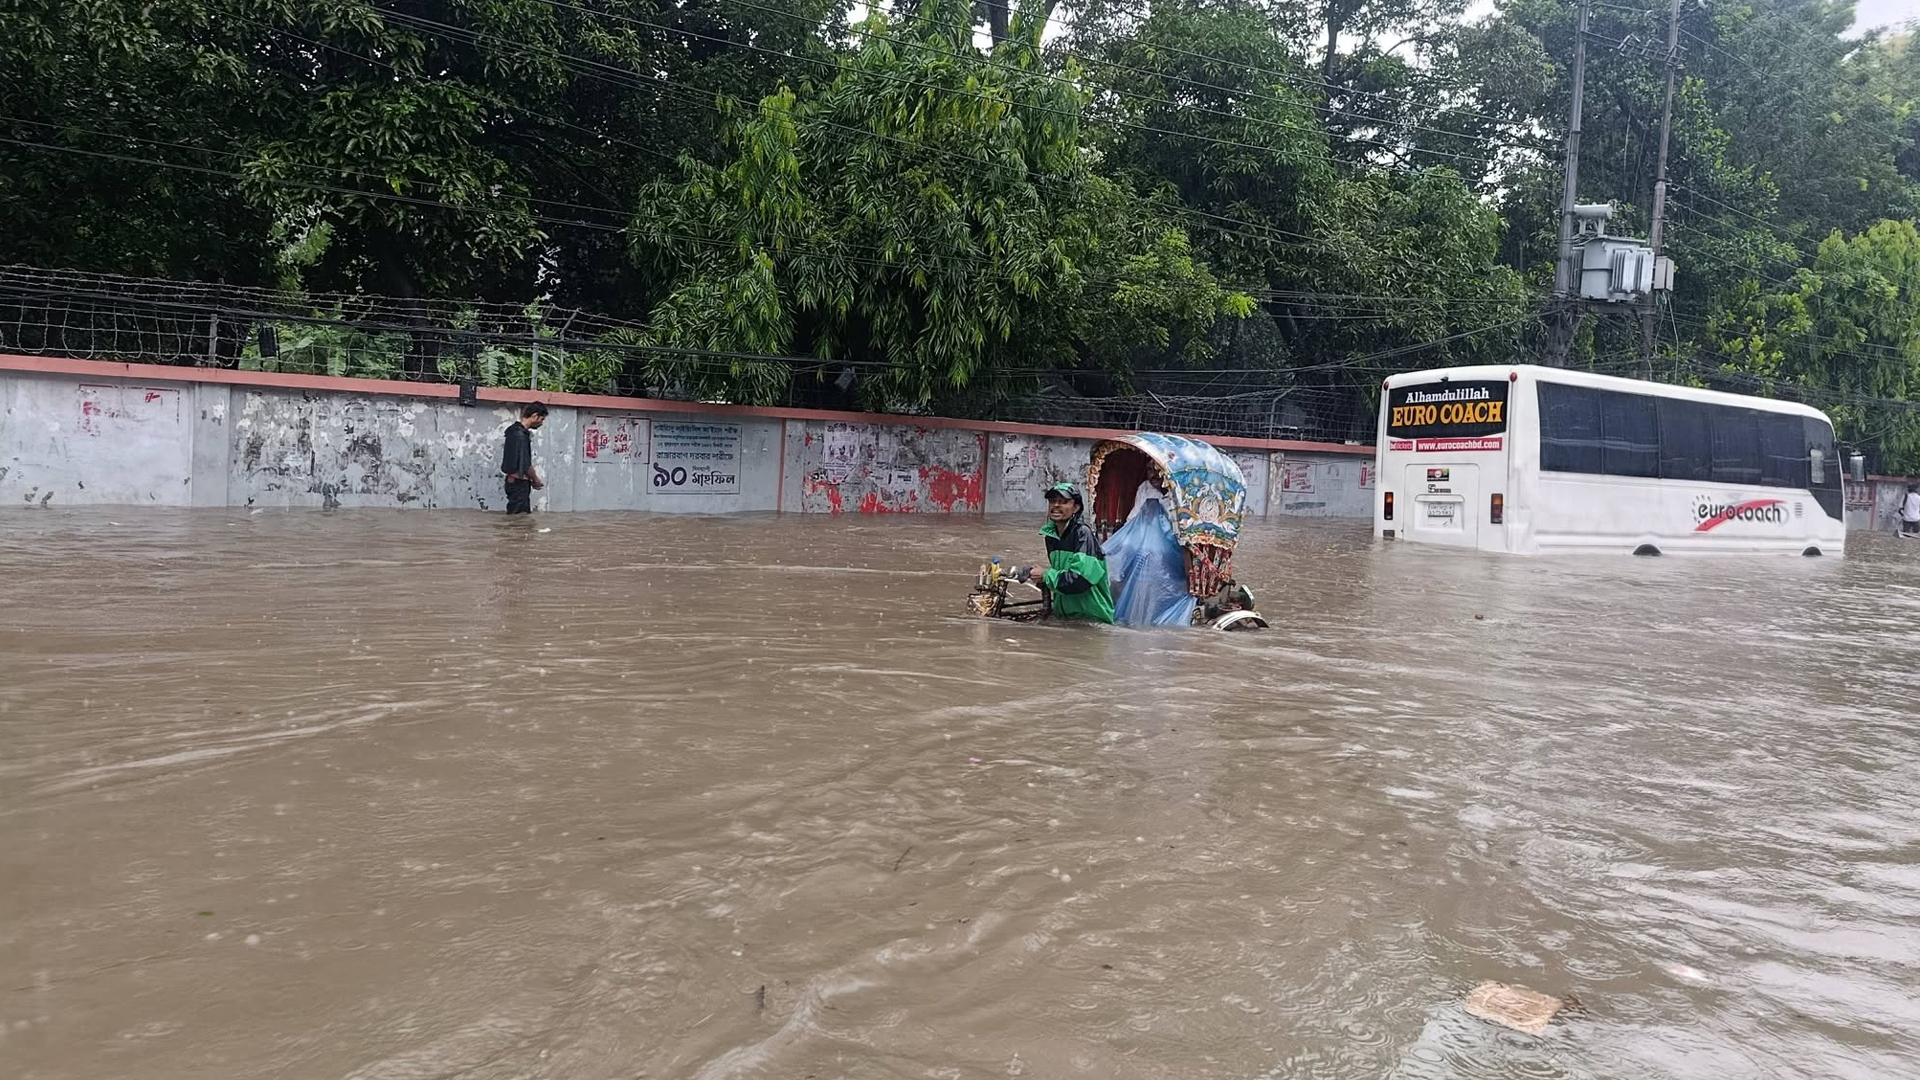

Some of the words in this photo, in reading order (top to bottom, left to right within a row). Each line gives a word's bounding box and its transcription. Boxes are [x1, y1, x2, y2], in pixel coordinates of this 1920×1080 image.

[1406, 387, 1489, 403] Alhamdulillah
[1392, 404, 1437, 427] EURO
[1440, 401, 1503, 424] COACH
[1418, 440, 1500, 451] www.eurocoachbd.com
[689, 451, 711, 461] দরবার
[653, 462, 687, 487] ৯০
[692, 471, 735, 487] মাহফিল
[1698, 503, 1781, 523] eurocoach
